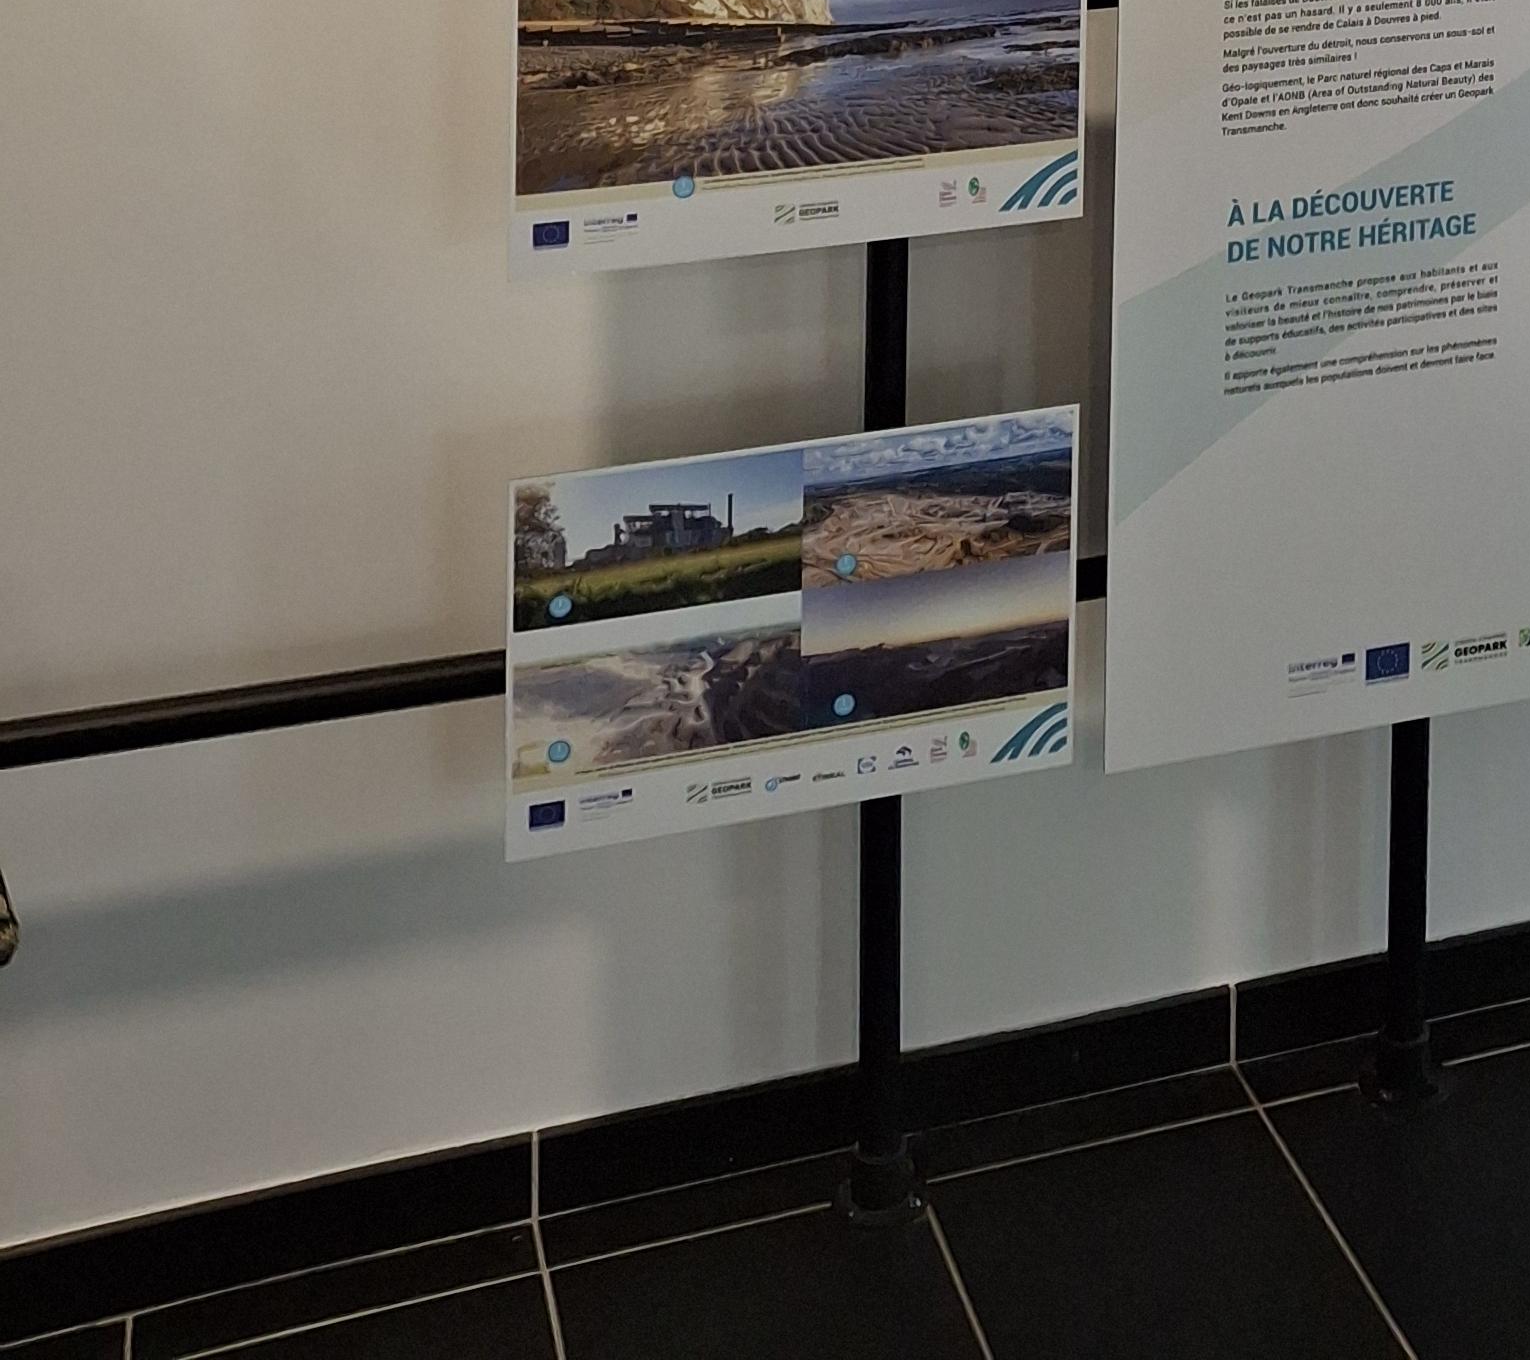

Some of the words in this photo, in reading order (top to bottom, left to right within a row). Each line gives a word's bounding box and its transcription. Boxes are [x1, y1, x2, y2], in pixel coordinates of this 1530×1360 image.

[1227, 198, 1245, 228] À
[1252, 199, 1285, 225] LA
[1292, 180, 1454, 220] DÉCOUVERTE
[1227, 238, 1260, 264] DE
[1267, 227, 1352, 259] NOTRE
[1358, 212, 1477, 248] HÉRITAGE
[1454, 640, 1508, 658] GEOPARK
